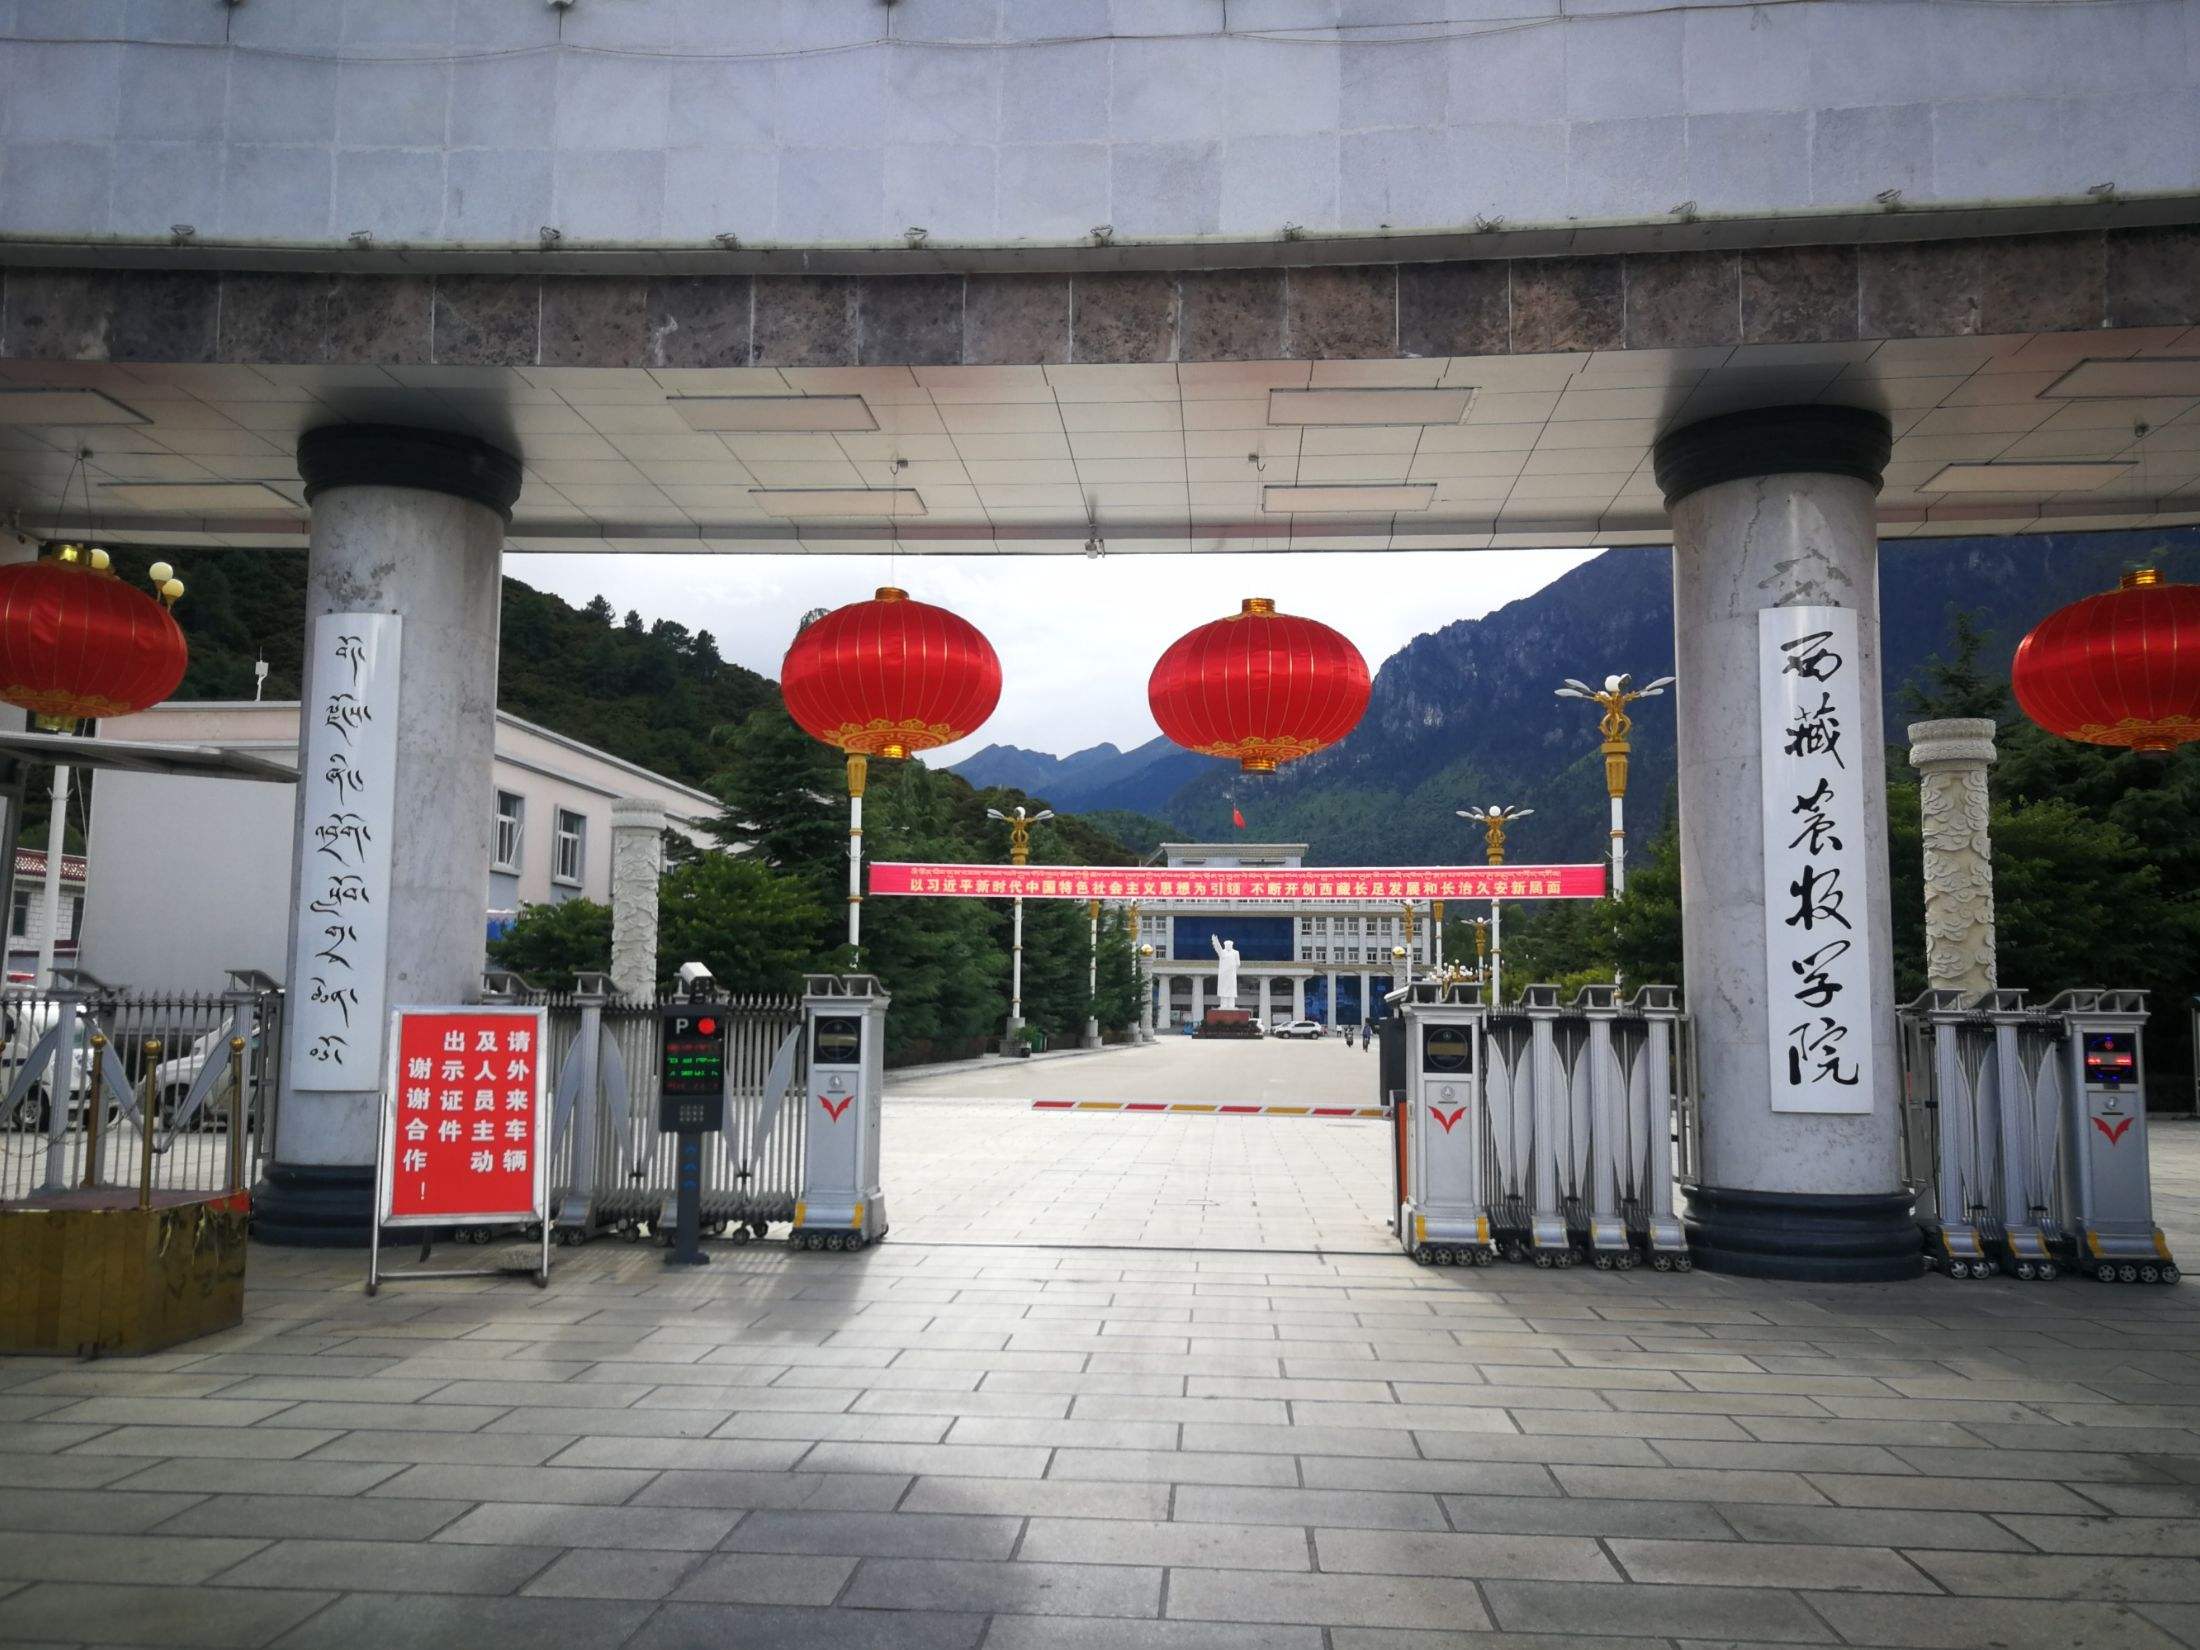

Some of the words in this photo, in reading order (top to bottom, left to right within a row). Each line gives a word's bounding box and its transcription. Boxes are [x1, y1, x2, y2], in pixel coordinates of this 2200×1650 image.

[909, 878, 1242, 897] 以习近平新时代中国特色社会主义思想为引领
[1250, 880, 1562, 896] 不断开创西藏长足发展和长治久安新局面
[438, 1029, 466, 1142] 出示证件
[675, 1018, 689, 1034] P
[403, 1057, 433, 1200] 谢谢合作！
[470, 1030, 498, 1173] 及人员主动
[502, 1030, 531, 1172] 请外来车辆
